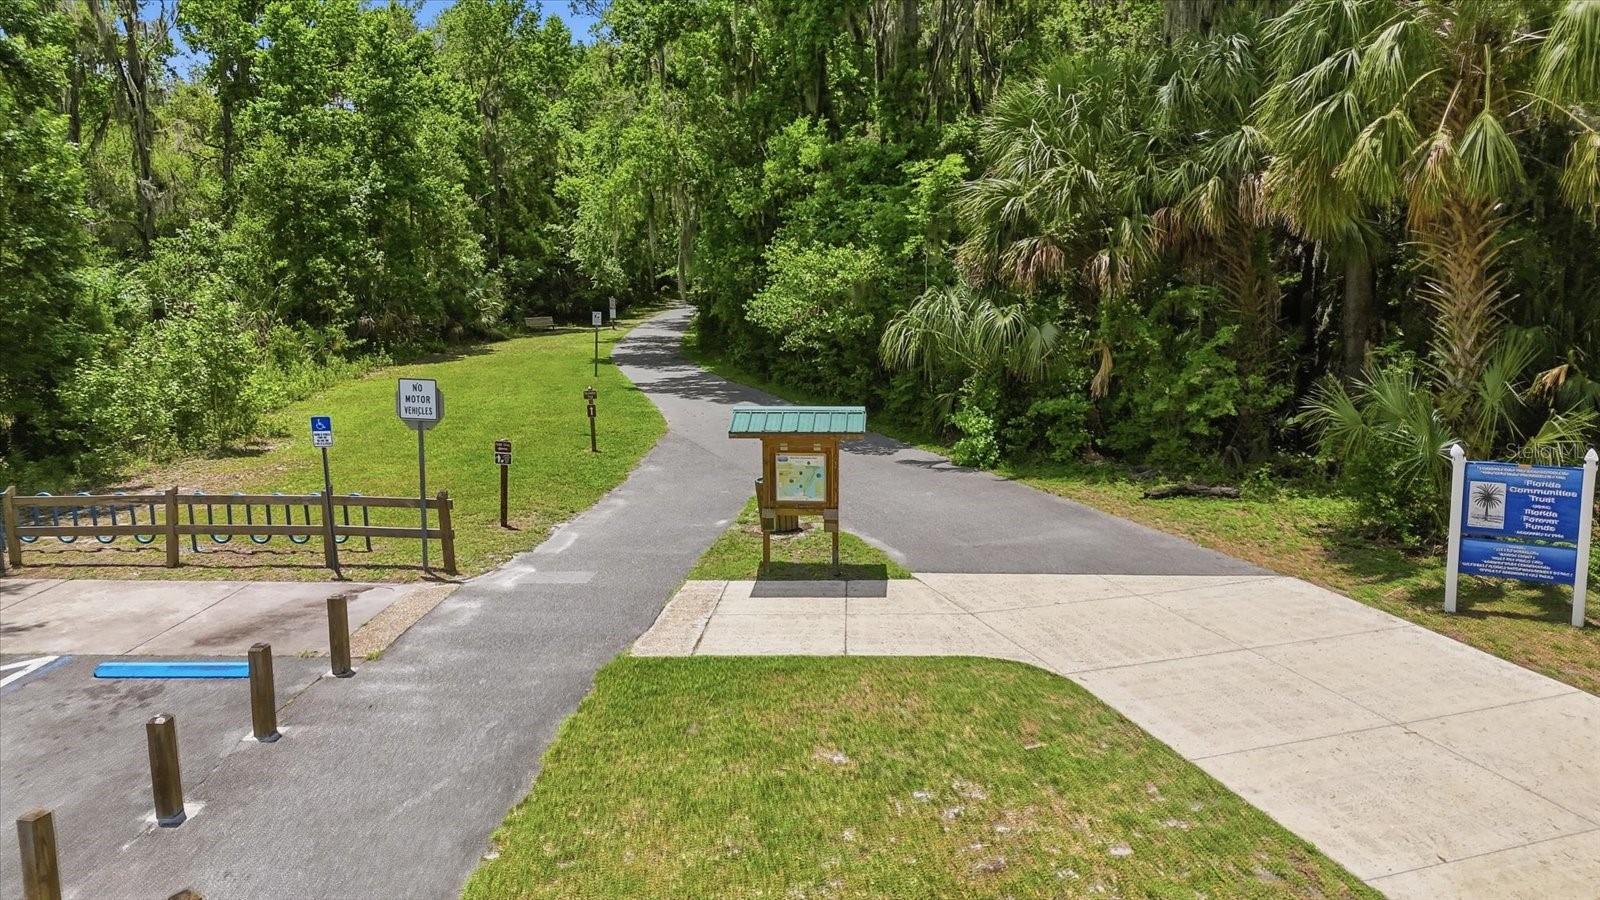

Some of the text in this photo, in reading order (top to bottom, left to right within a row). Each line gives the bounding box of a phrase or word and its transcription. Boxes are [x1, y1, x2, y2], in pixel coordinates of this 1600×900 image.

[412, 383, 423, 392] NO
[405, 395, 431, 404] MOTOR
[404, 406, 433, 415] VEHICLES
